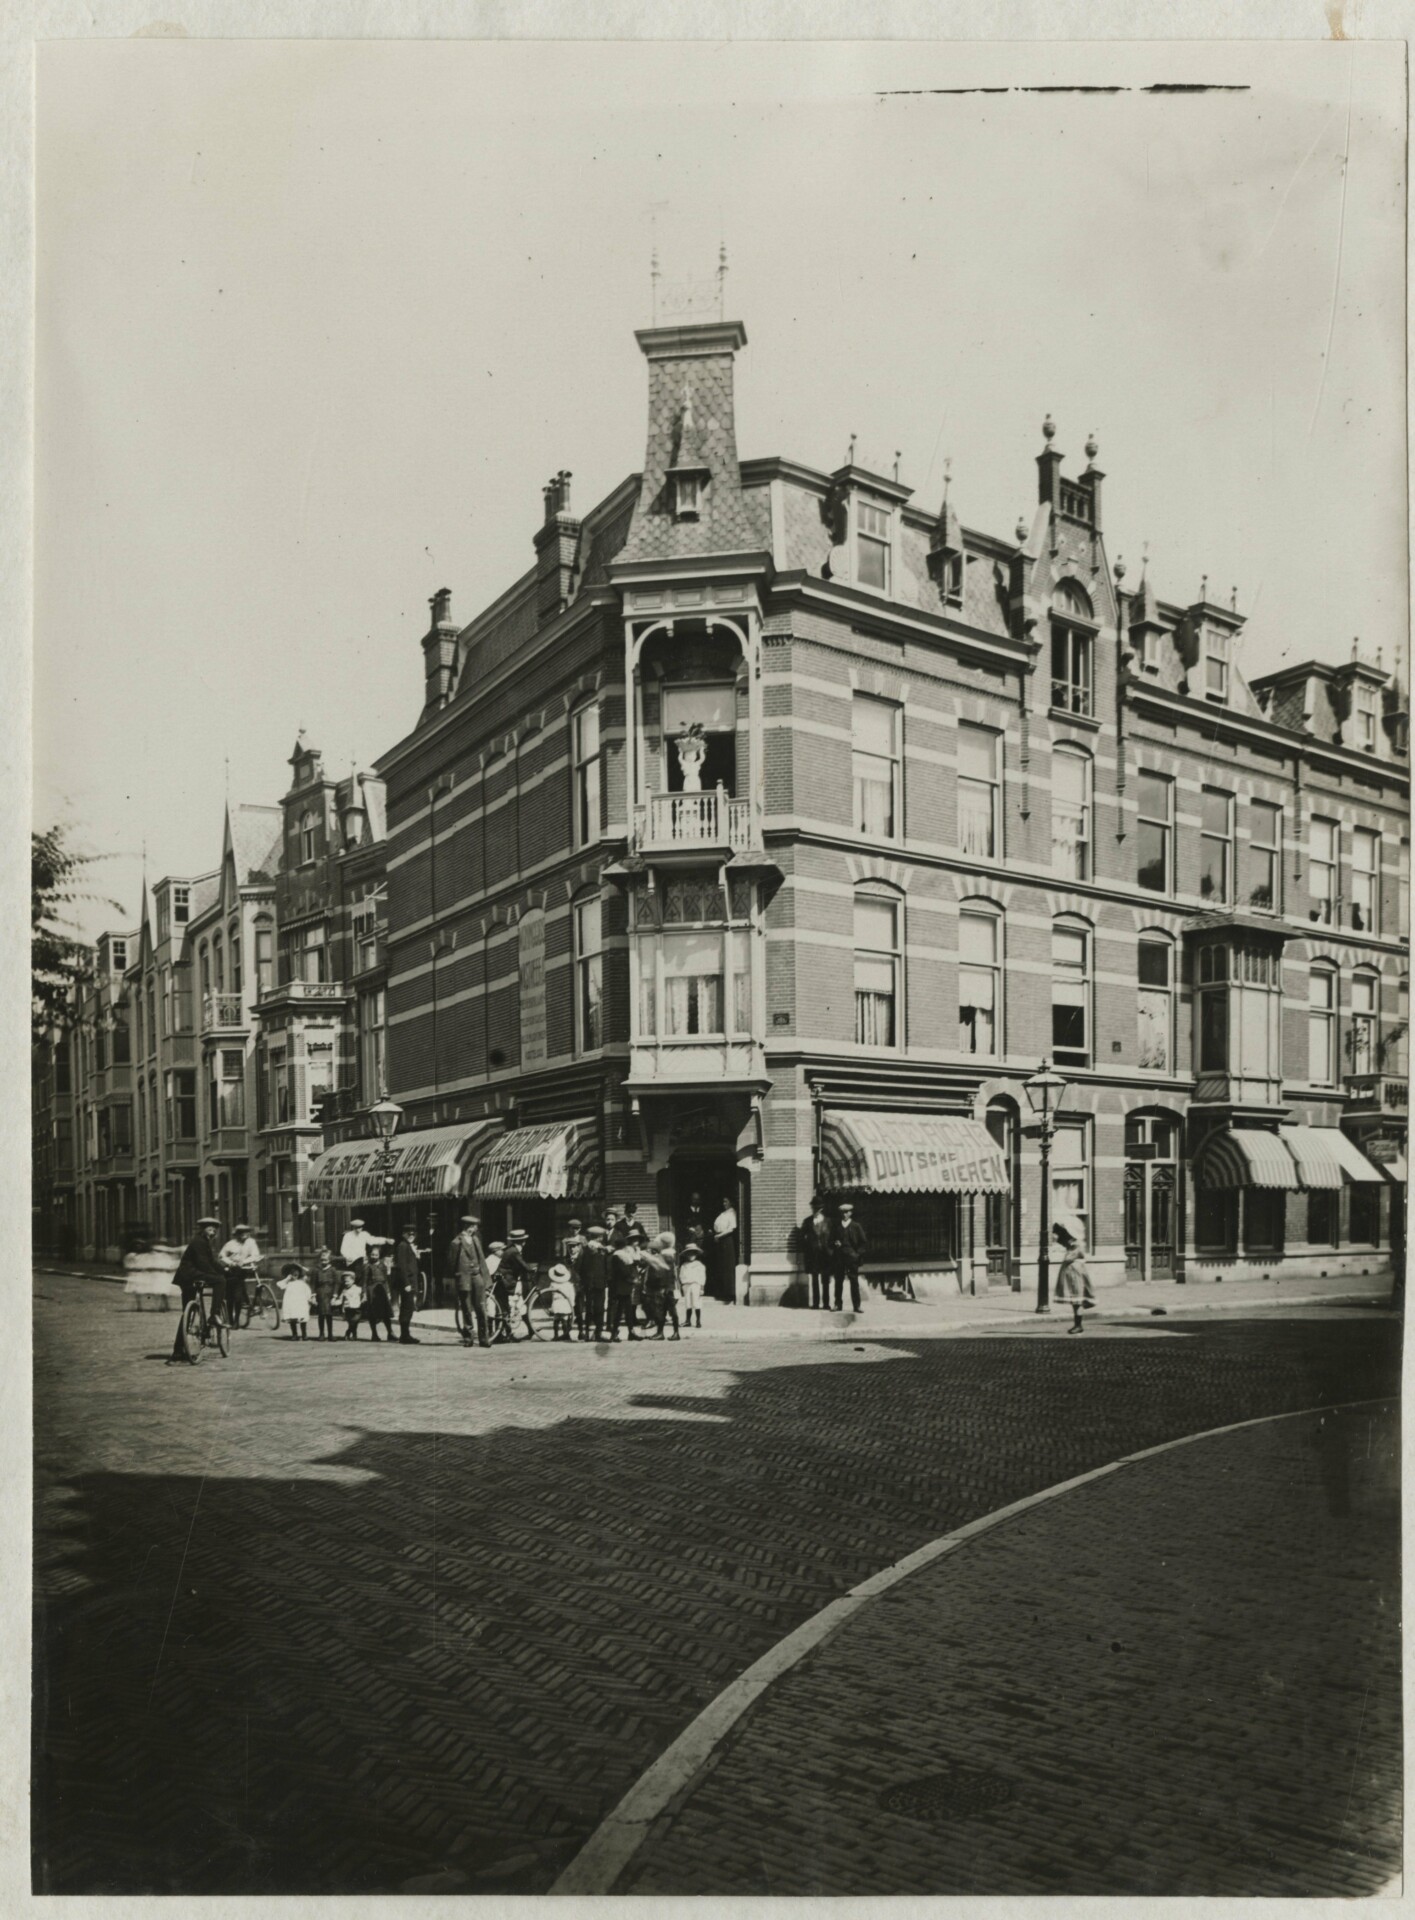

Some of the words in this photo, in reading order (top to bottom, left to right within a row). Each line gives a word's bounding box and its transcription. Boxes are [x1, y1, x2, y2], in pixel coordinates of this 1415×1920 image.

[403, 1143, 437, 1169] VAN
[872, 1149, 957, 1181] DUITSCHE
[941, 1153, 1005, 1183] BIEREN
[338, 1176, 358, 1199] VAN
[503, 1155, 545, 1190] BIEREN
